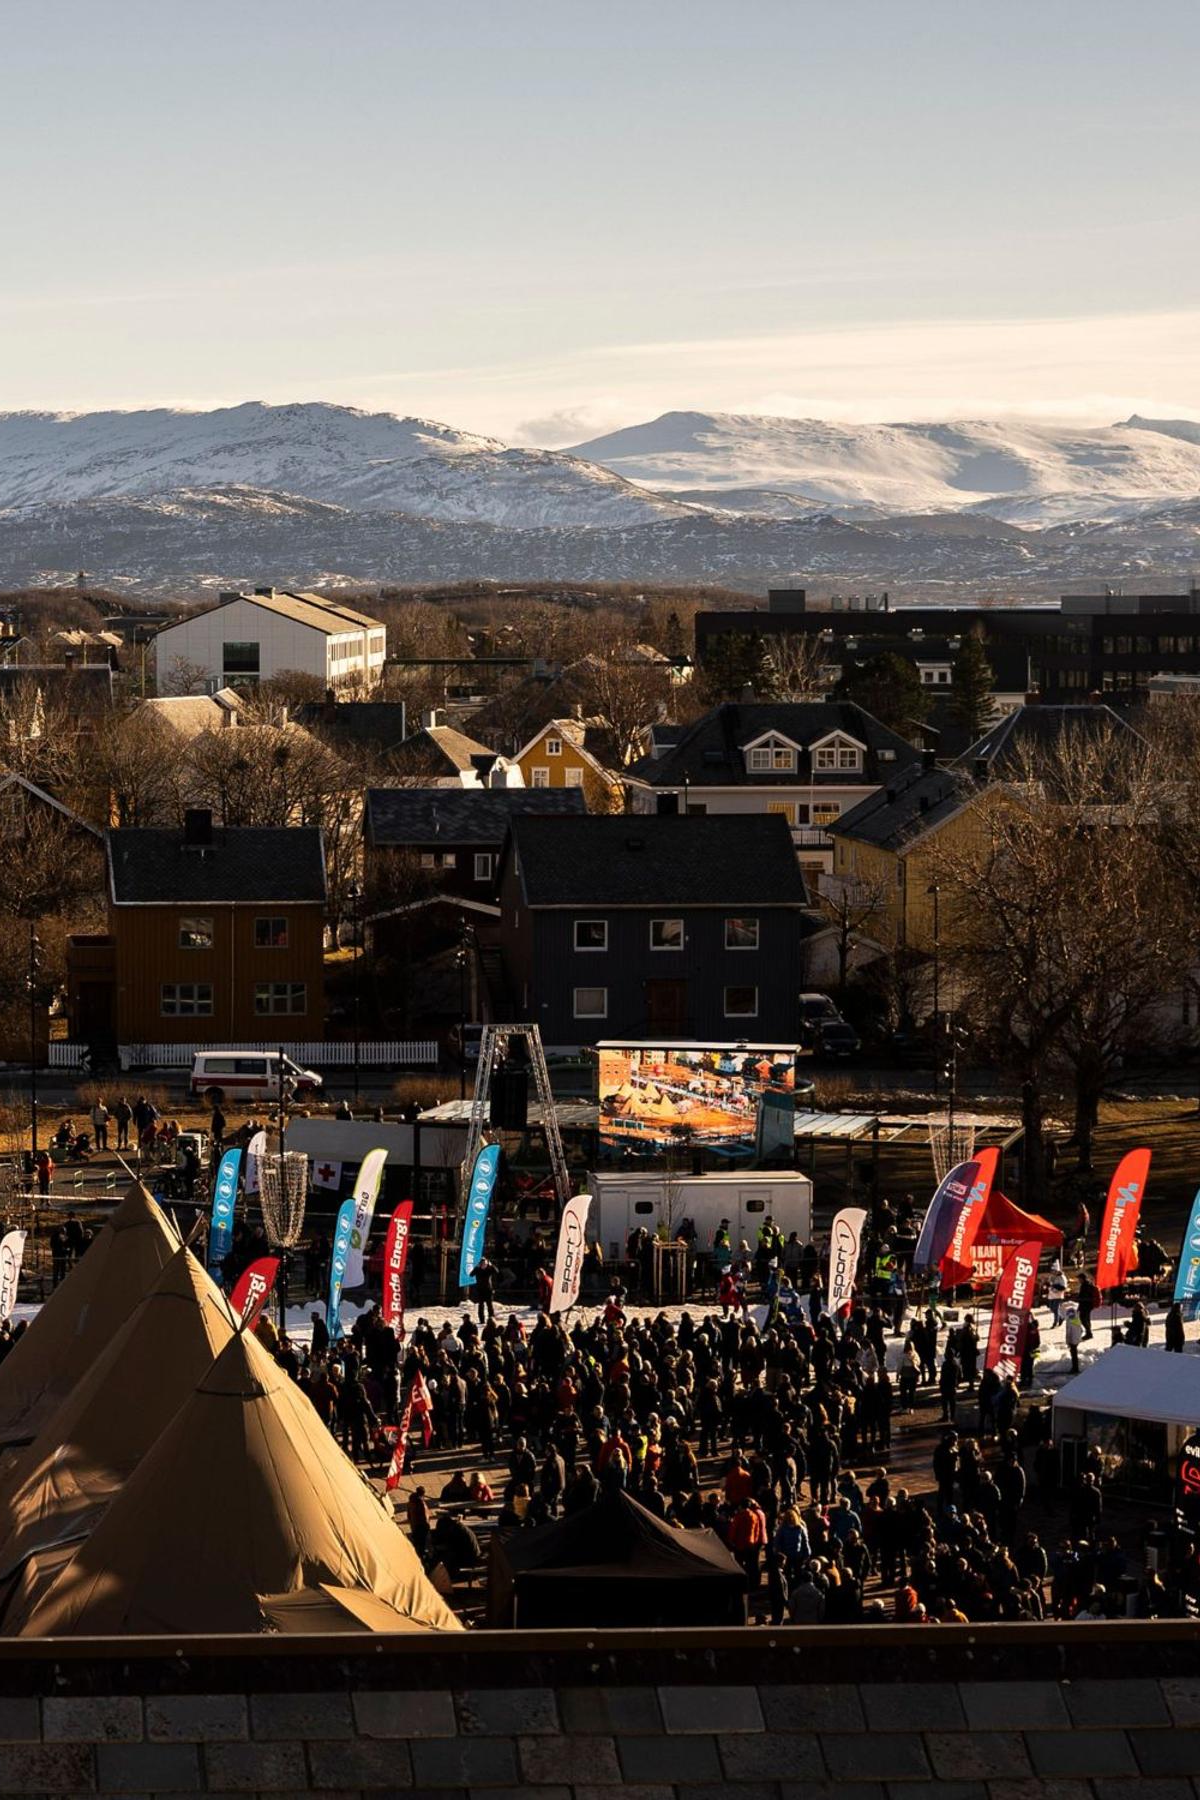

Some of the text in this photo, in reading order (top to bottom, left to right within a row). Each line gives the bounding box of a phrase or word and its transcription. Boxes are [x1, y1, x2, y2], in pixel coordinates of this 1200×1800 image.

[953, 1206, 972, 1262] NorEngros
[1105, 1207, 1125, 1264] NorEngros
[389, 1217, 408, 1312] Bodø Energi
[562, 1238, 575, 1294] sport
[833, 1245, 847, 1298] sport
[1000, 1256, 1033, 1355] Bodø Energi
